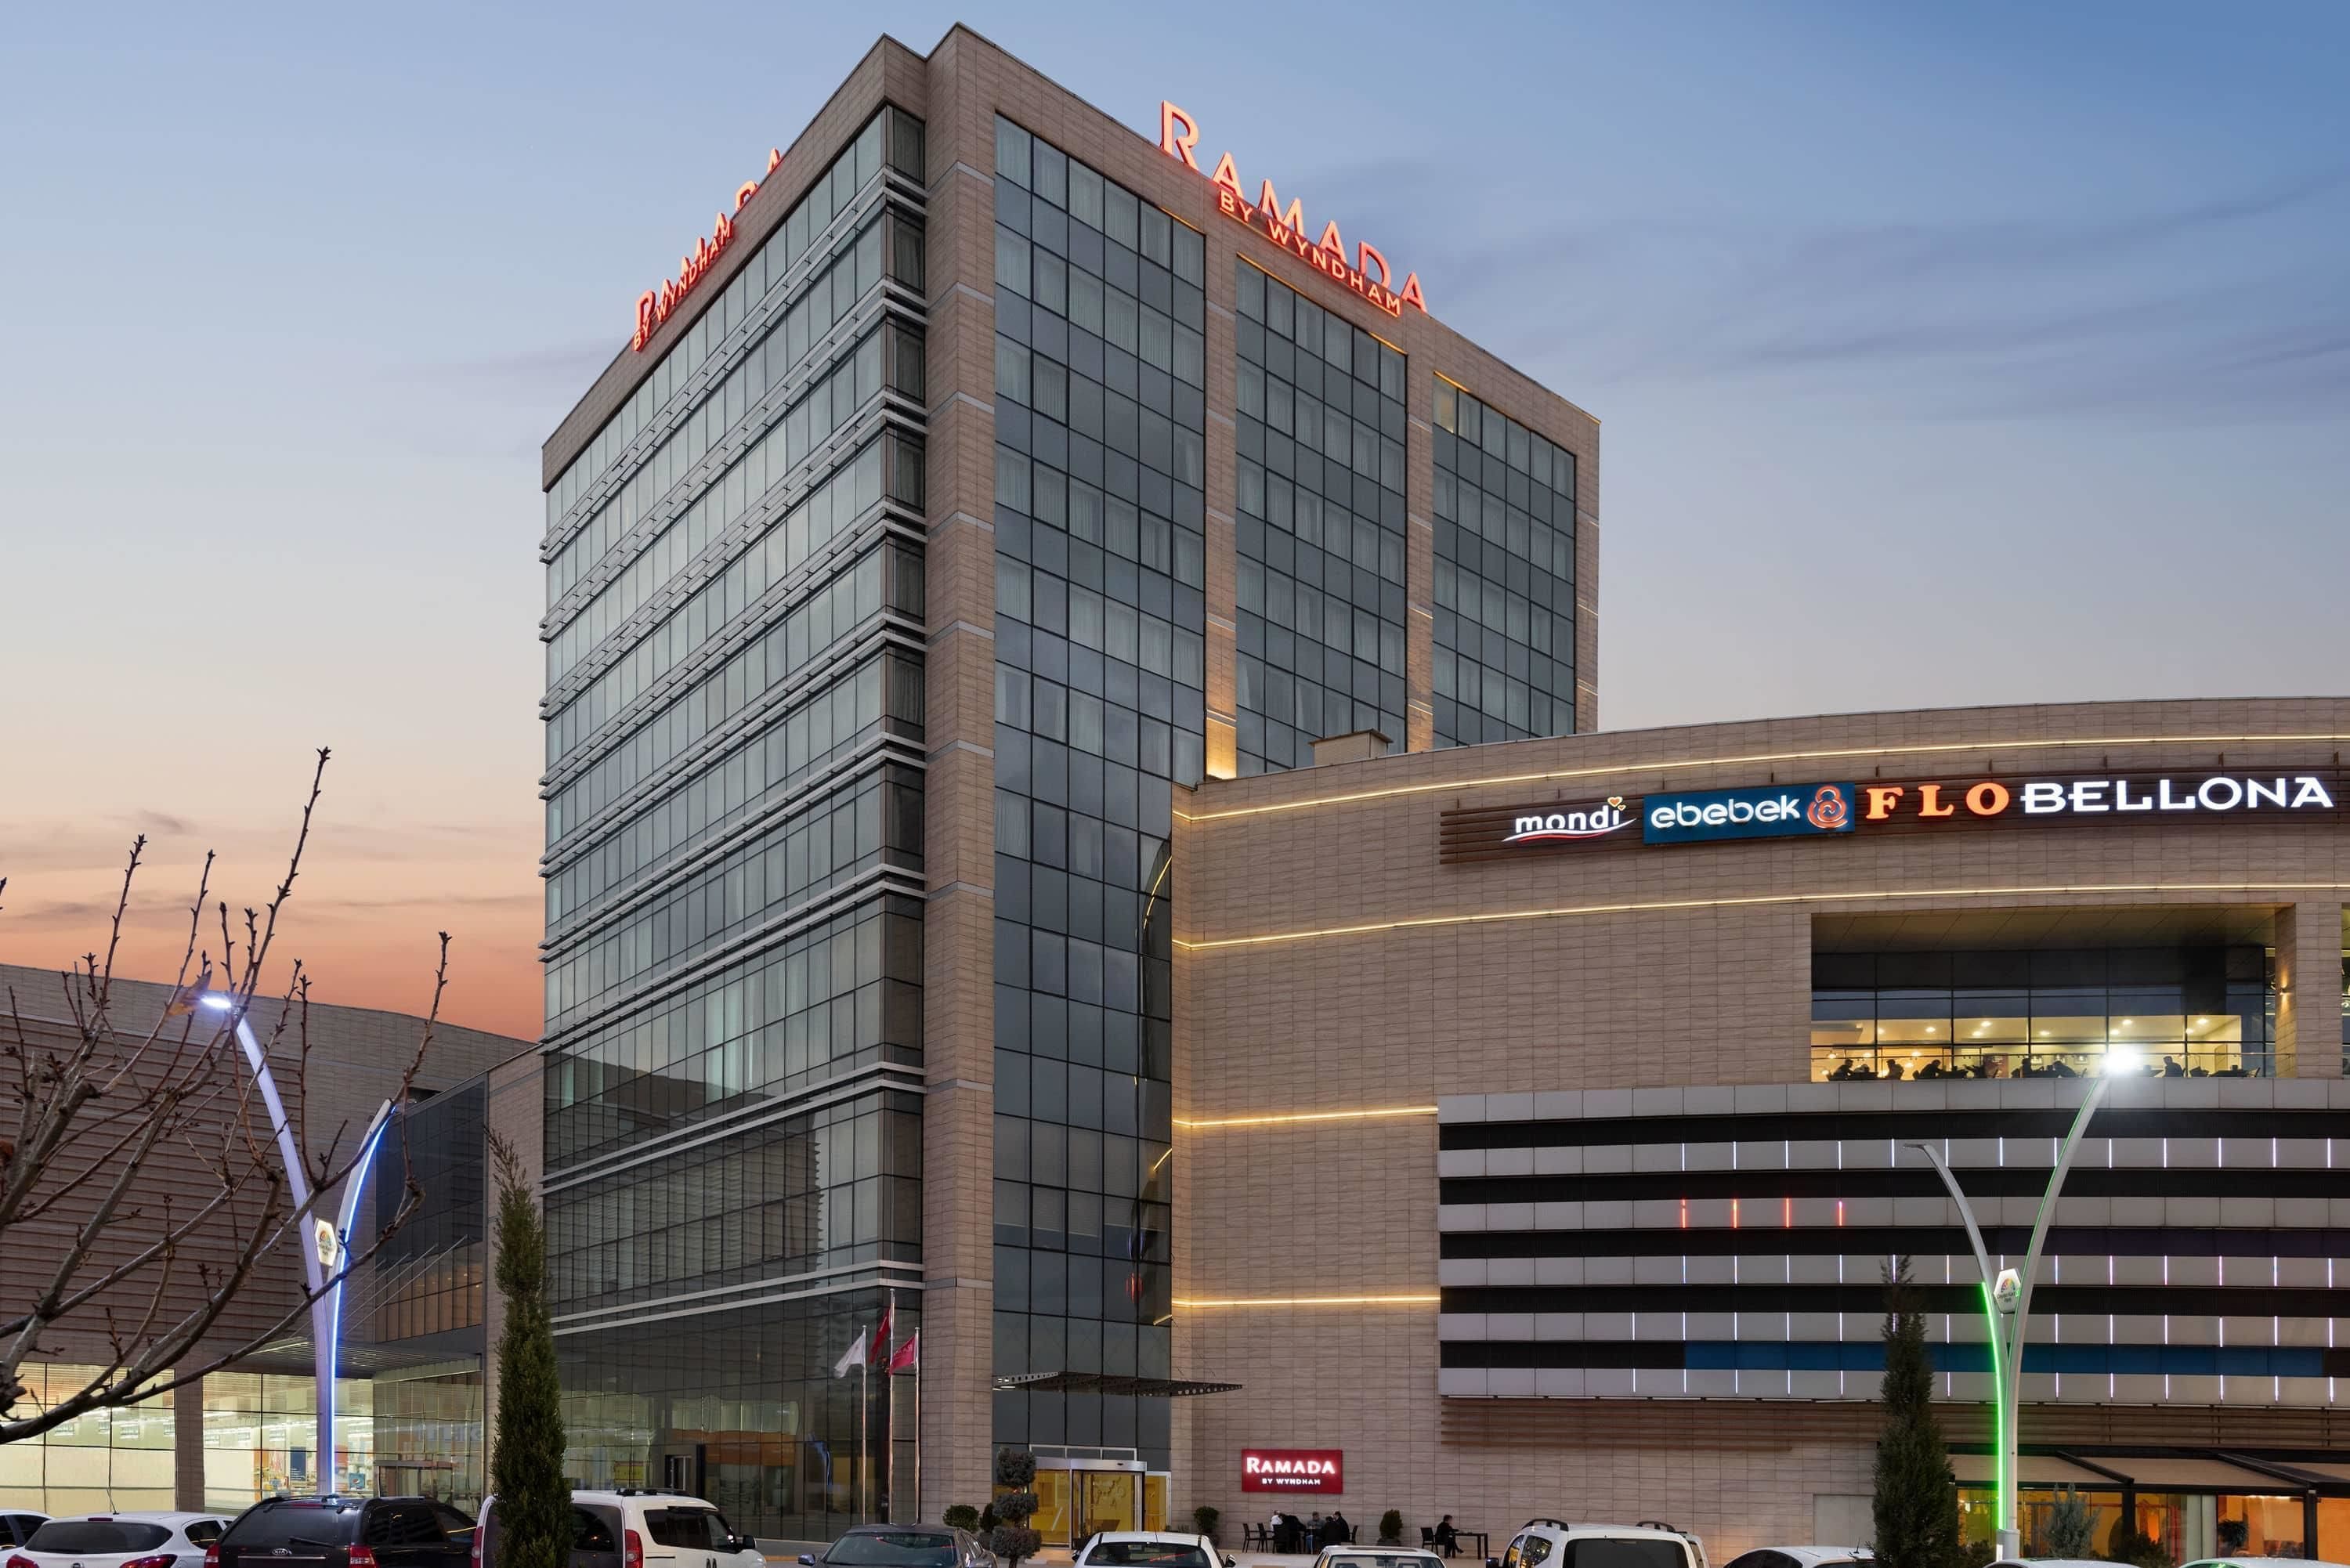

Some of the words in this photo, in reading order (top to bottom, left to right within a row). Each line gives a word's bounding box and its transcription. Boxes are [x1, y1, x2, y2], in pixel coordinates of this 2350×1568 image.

[1161, 100, 1428, 313] RAMADA
[1219, 190, 1254, 223] BY
[1267, 219, 1401, 316] WYNDHAM
[633, 316, 653, 352] BY
[656, 220, 734, 323] WYNDHAM
[1650, 795, 1801, 829] ebebek
[1865, 782, 2010, 820] FLO
[2019, 776, 2334, 815] BELLONA
[1515, 804, 1621, 833] mondi
[1246, 1456, 1336, 1474] RAMADA
